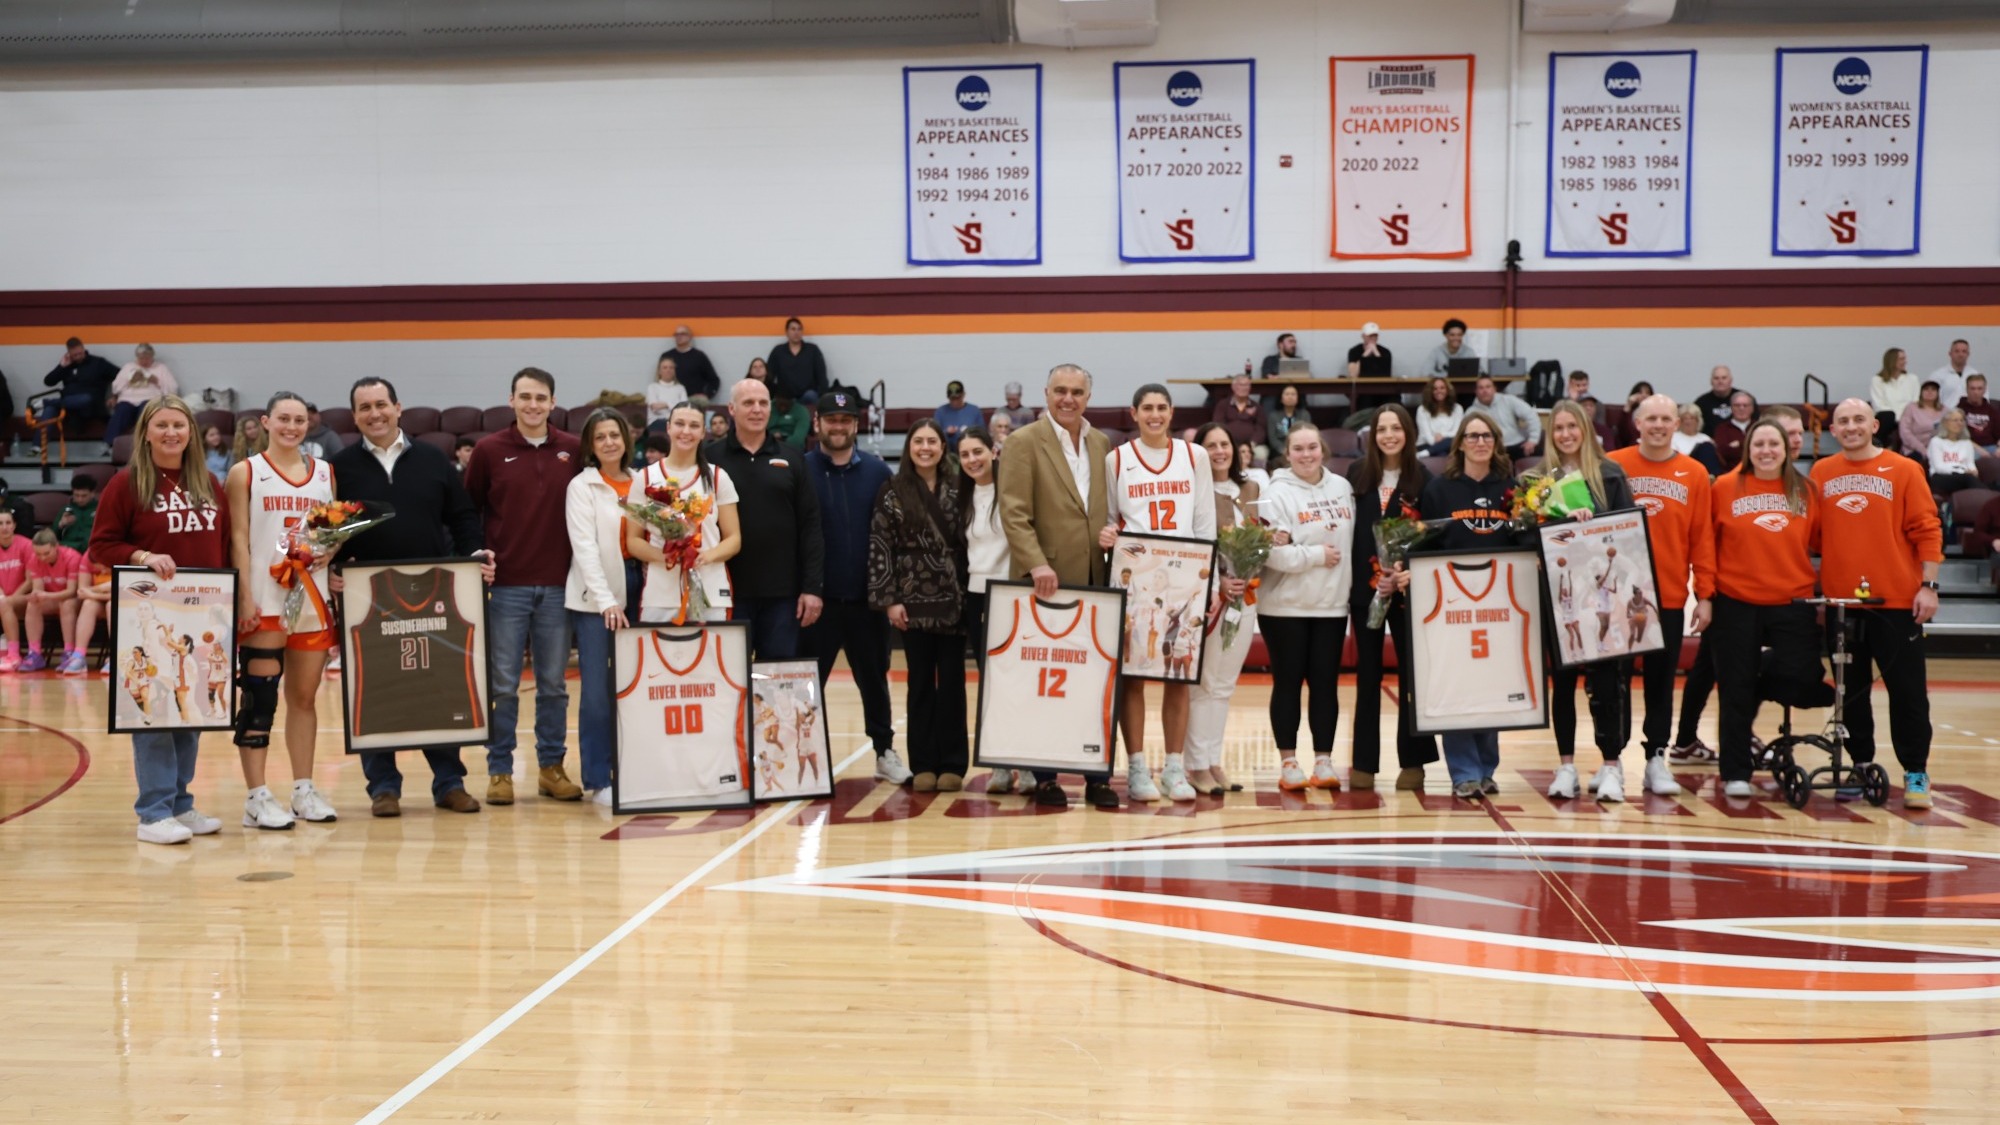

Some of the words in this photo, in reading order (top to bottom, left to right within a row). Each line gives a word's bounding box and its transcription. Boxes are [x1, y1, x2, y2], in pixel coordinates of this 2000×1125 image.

[1607, 78, 1641, 91] NCAA
[1836, 74, 1871, 86] NCAA
[958, 92, 991, 103] NCAA
[1169, 88, 1202, 99] NCAA
[1350, 105, 1383, 115] MEN'S
[1385, 104, 1450, 115] BASKETBALL
[1561, 105, 1614, 115] WOMEN'S
[1615, 104, 1681, 114] BASKETBALL
[1789, 102, 1842, 112] WOMEN'S
[1844, 101, 1911, 111] BASKETBALL
[924, 118, 956, 127] MEN'S
[957, 117, 1019, 127] BASKETBALL
[1136, 114, 1166, 123] MEN'S
[1169, 113, 1233, 123] BASKETBALL
[1341, 117, 1460, 134] CHAMPIONS
[1561, 117, 1682, 132] APPEARANCES
[1788, 114, 1911, 129] APPEARANCES
[916, 129, 1029, 144] APPEARANCES
[1127, 125, 1243, 140] APPEARANCES
[1341, 158, 1378, 172] 2020
[1382, 157, 1419, 171] 2022
[1561, 156, 1595, 169] 1982
[1602, 156, 1636, 169] 1983
[1644, 155, 1679, 168] 1984
[1787, 154, 1822, 167] 1992
[1832, 153, 1867, 167] 1993
[1874, 153, 1909, 166] 1999
[917, 167, 948, 180] 1984
[956, 167, 989, 180] 1986
[996, 166, 1029, 180] 1989
[1127, 164, 1161, 177] 2017
[1167, 163, 1202, 176] 2020
[1207, 162, 1242, 175] 2022
[1560, 178, 1594, 192] 1985
[1602, 178, 1637, 191] 1986
[1647, 177, 1680, 191] 1991
[916, 189, 948, 202] 1992
[957, 189, 989, 202] 1994
[993, 188, 1029, 202] 2016
[1128, 481, 1155, 499] RIVER
[1157, 480, 1191, 497] HAWKS
[1823, 473, 1893, 501] SUSQUEHANNA
[263, 496, 293, 511] RIVER
[166, 509, 217, 533] DAY
[1148, 500, 1177, 530] 12
[1152, 548, 1176, 557] CARLY
[1178, 550, 1208, 560] GEORGE
[1168, 560, 1182, 568] #12
[198, 586, 221, 594] ROTH
[184, 597, 200, 605] #21
[1446, 609, 1473, 625] RIVER
[1475, 608, 1510, 623] HAWKS
[381, 616, 447, 635] SUSQUEHANNA
[1470, 629, 1489, 659] 5
[401, 637, 430, 670] 21
[1021, 646, 1048, 662] RIVER
[1051, 647, 1087, 664] HAWKS
[1037, 667, 1067, 698] 12
[648, 684, 677, 701] RIVER
[680, 683, 716, 698] HAWKS
[664, 704, 703, 735] 00
